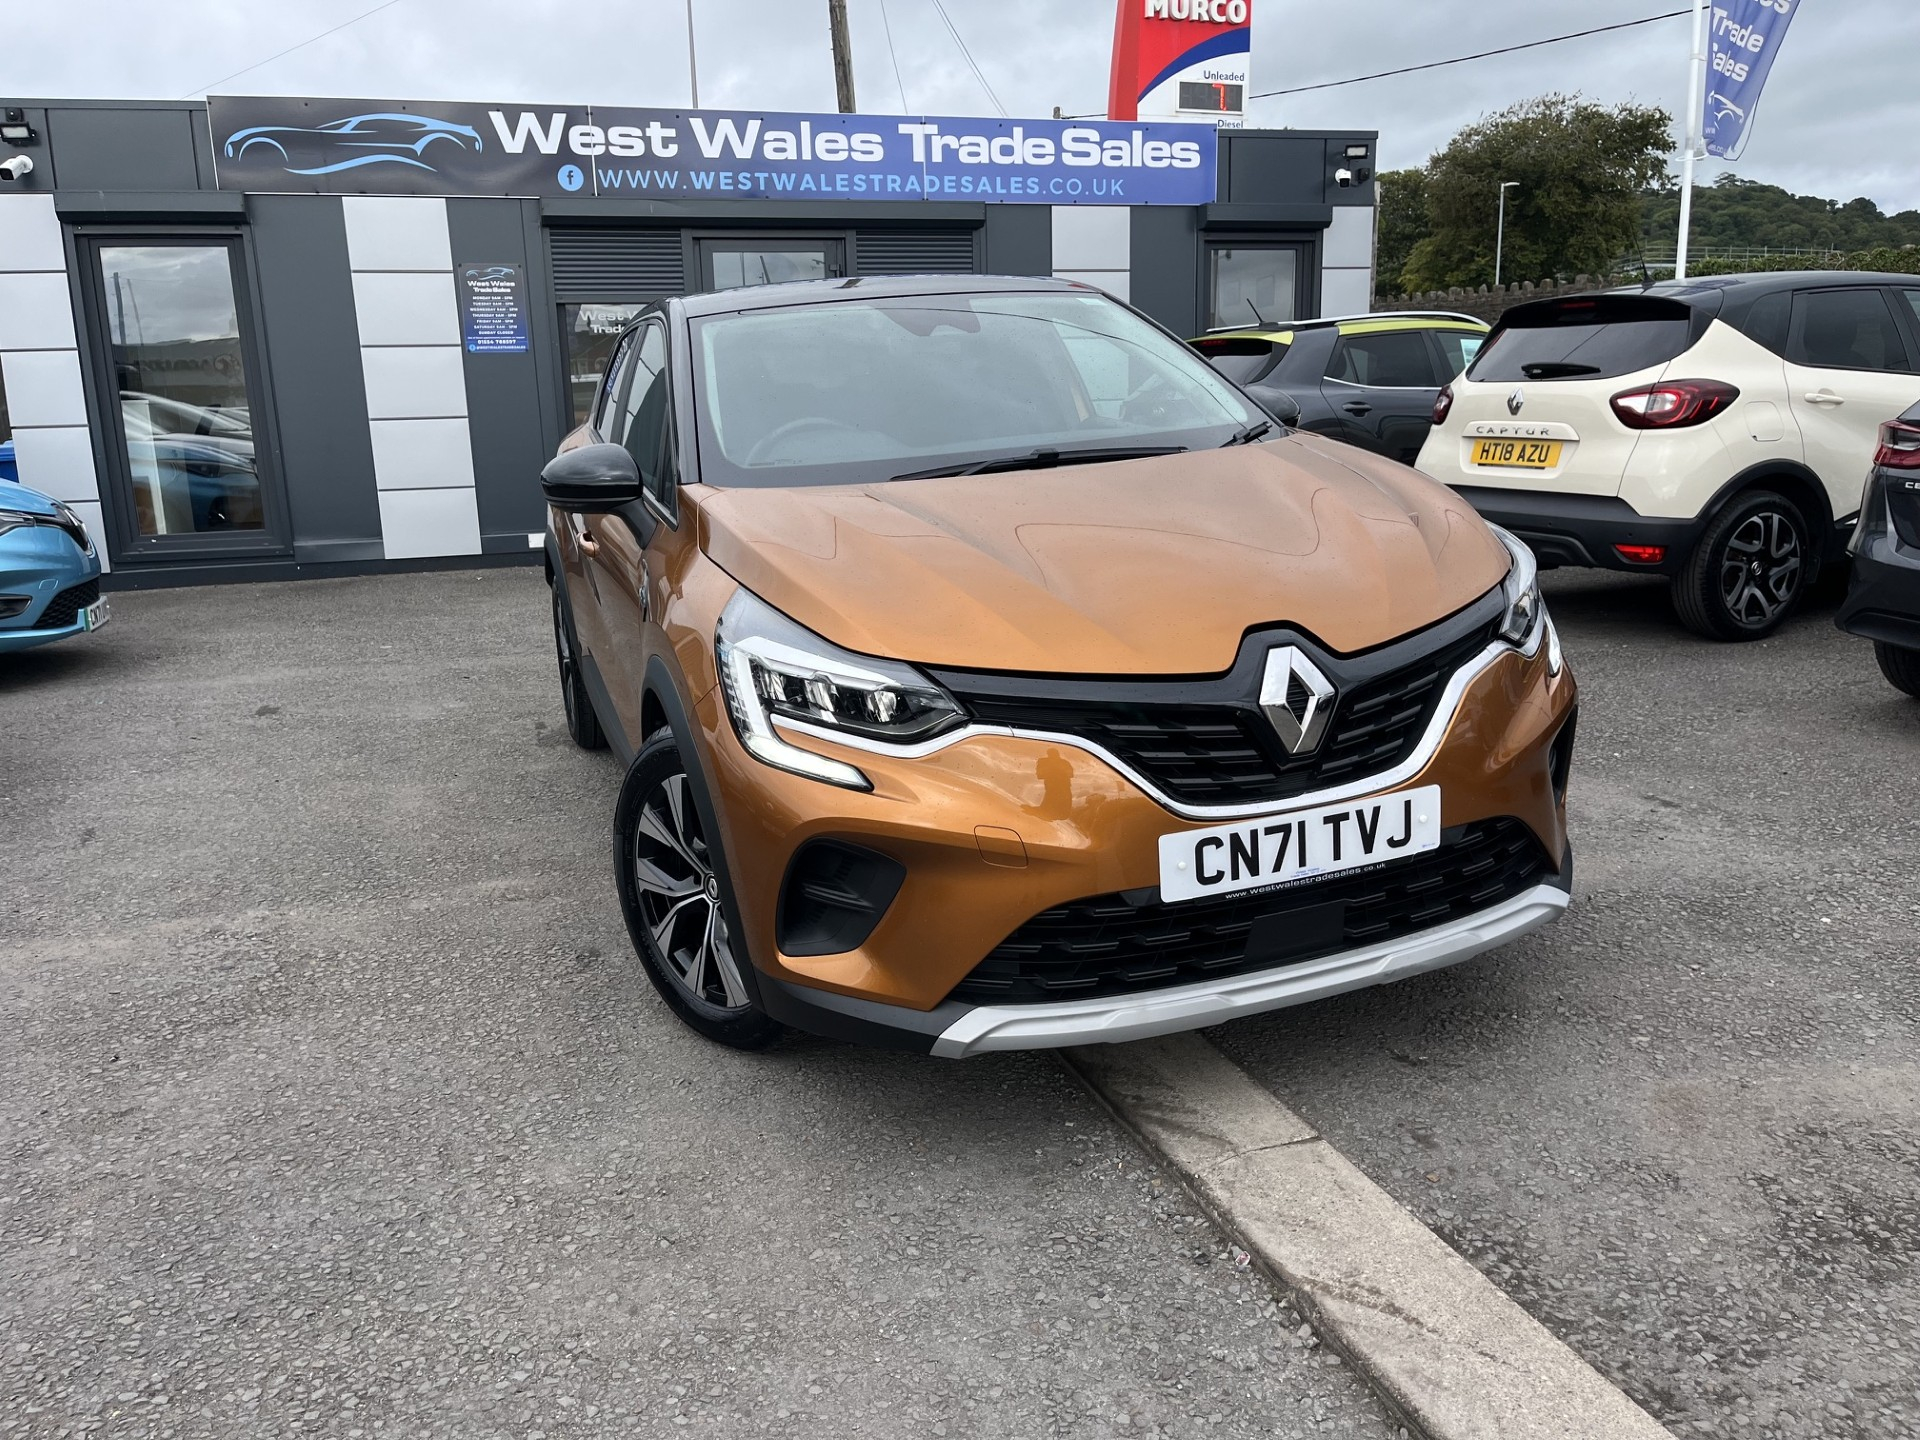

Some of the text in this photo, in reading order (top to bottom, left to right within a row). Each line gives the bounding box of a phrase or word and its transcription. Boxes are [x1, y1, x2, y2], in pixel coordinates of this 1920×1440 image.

[1145, 0, 1247, 24] MURCO
[1713, 6, 1764, 53] Trade
[1203, 70, 1245, 82] Unleaded
[1217, 119, 1244, 128] Diesel
[488, 110, 1201, 169] West Wales Trade Sales
[598, 169, 1125, 196] WWW.WESTWALESTRADESALES.CO.UK
[580, 310, 622, 321] West
[1475, 426, 1550, 436] CAPTUR
[1480, 442, 1551, 463] HT18 AZU
[1194, 799, 1412, 886] CN71 TVJ
[1225, 862, 1387, 899] www.westwalestradesales.co.uk
